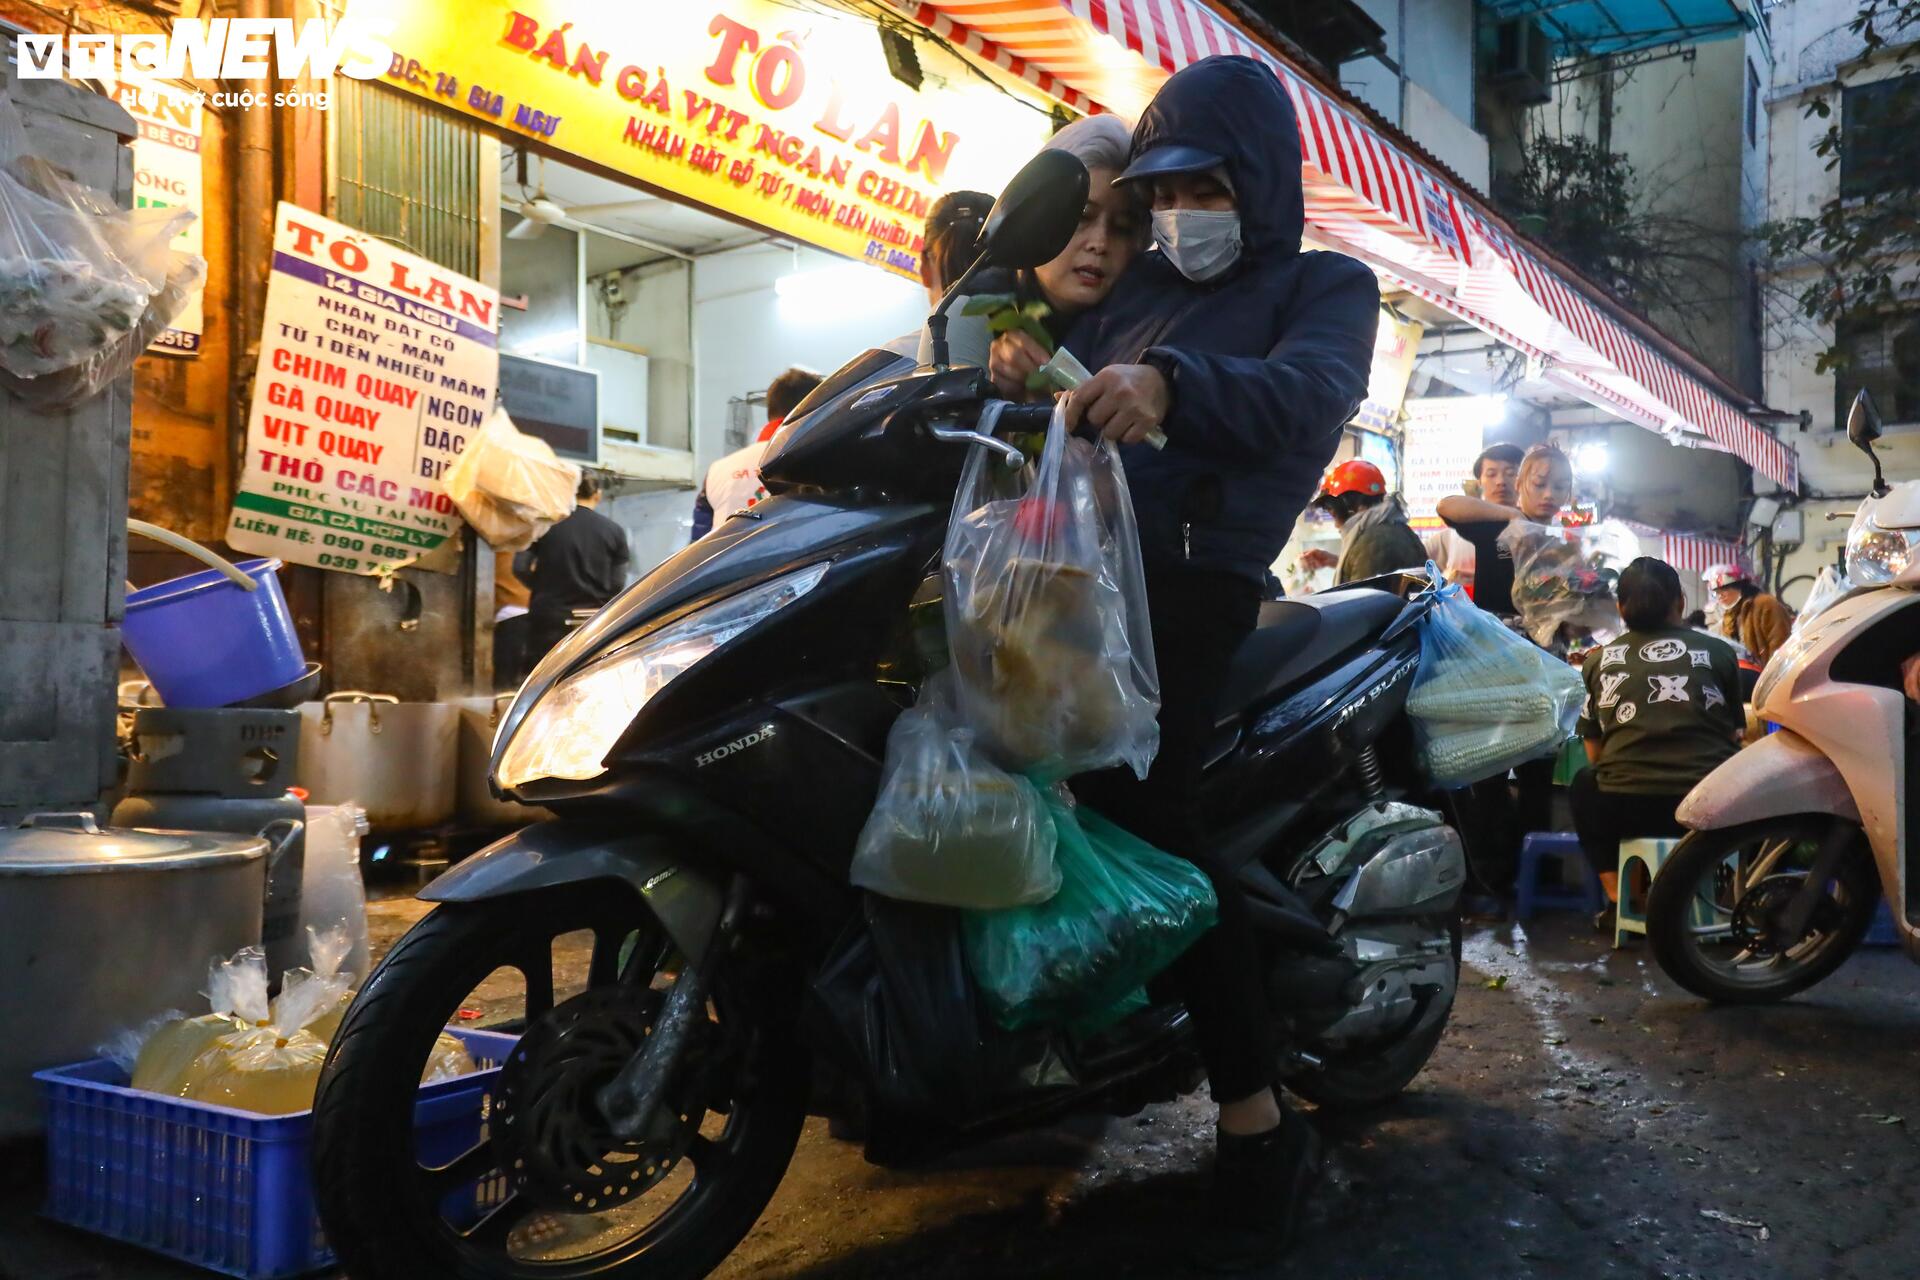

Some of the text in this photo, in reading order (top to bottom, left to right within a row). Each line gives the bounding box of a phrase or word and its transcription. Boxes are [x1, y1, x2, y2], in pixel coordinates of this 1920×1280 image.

[433, 70, 459, 98] 14
[467, 85, 505, 117] GIA
[502, 10, 610, 84] BÁN
[616, 65, 671, 114] GÀ
[683, 89, 750, 139] VỊT
[753, 123, 852, 188] NGAN
[813, 80, 961, 184] LAN
[287, 220, 492, 325] TỐ LAN
[325, 272, 353, 294] 14
[357, 284, 400, 312] GIA
[314, 334, 323, 349] 1
[326, 318, 380, 345] CHAY
[272, 348, 419, 410] CHIM QUAY
[267, 382, 381, 432] GÀ QUAY
[427, 395, 483, 430] NGON
[263, 414, 384, 465] VỊT QUAY
[258, 449, 324, 483] THỎ
[337, 468, 398, 501] CÁC
[287, 504, 323, 522] GIÁ
[317, 552, 359, 571] 039
[323, 533, 365, 553] 090
[371, 542, 408, 561] 685
[1368, 654, 1420, 701] BLADE
[694, 723, 776, 767] HONDA
